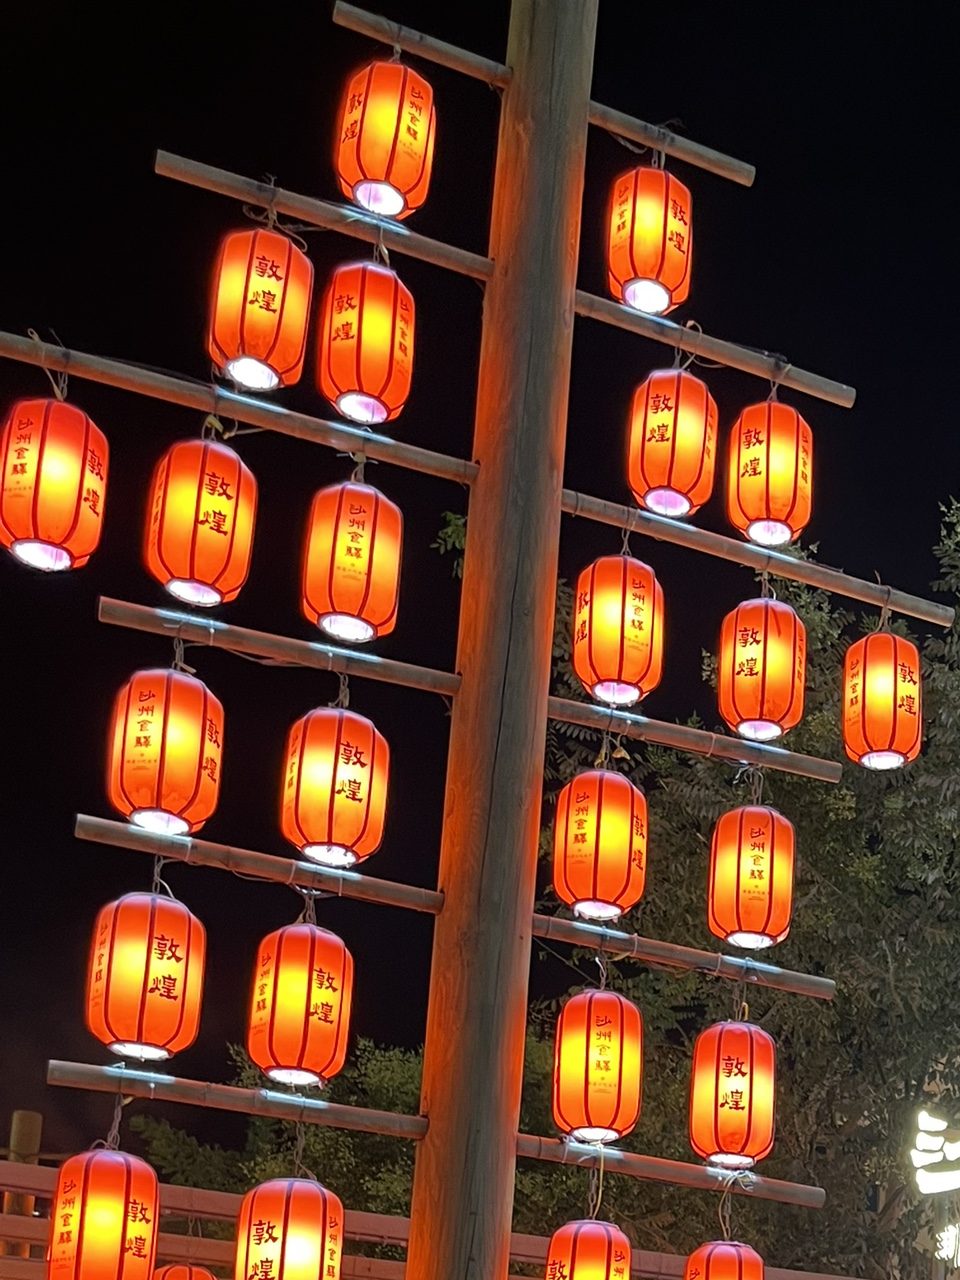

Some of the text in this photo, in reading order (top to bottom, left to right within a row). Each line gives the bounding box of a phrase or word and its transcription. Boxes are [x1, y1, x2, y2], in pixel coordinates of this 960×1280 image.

[668, 199, 688, 254] 敦煌
[248, 255, 284, 314] 敦煌
[332, 294, 357, 342] 敦煌
[647, 394, 673, 443] 敦煌
[741, 428, 764, 478] 敦煌
[83, 448, 104, 517] 敦煌
[197, 472, 234, 536] 敦煌
[736, 627, 762, 677] 敦煌
[898, 662, 918, 716] 敦煌
[202, 718, 220, 784] 敦煌
[335, 740, 368, 803] 敦煌
[632, 815, 645, 872] 敦煌
[148, 934, 183, 1001] 敦煌
[310, 968, 338, 1024] 敦煌
[720, 1055, 748, 1112] 敦煌
[124, 1199, 151, 1259] 敦煌
